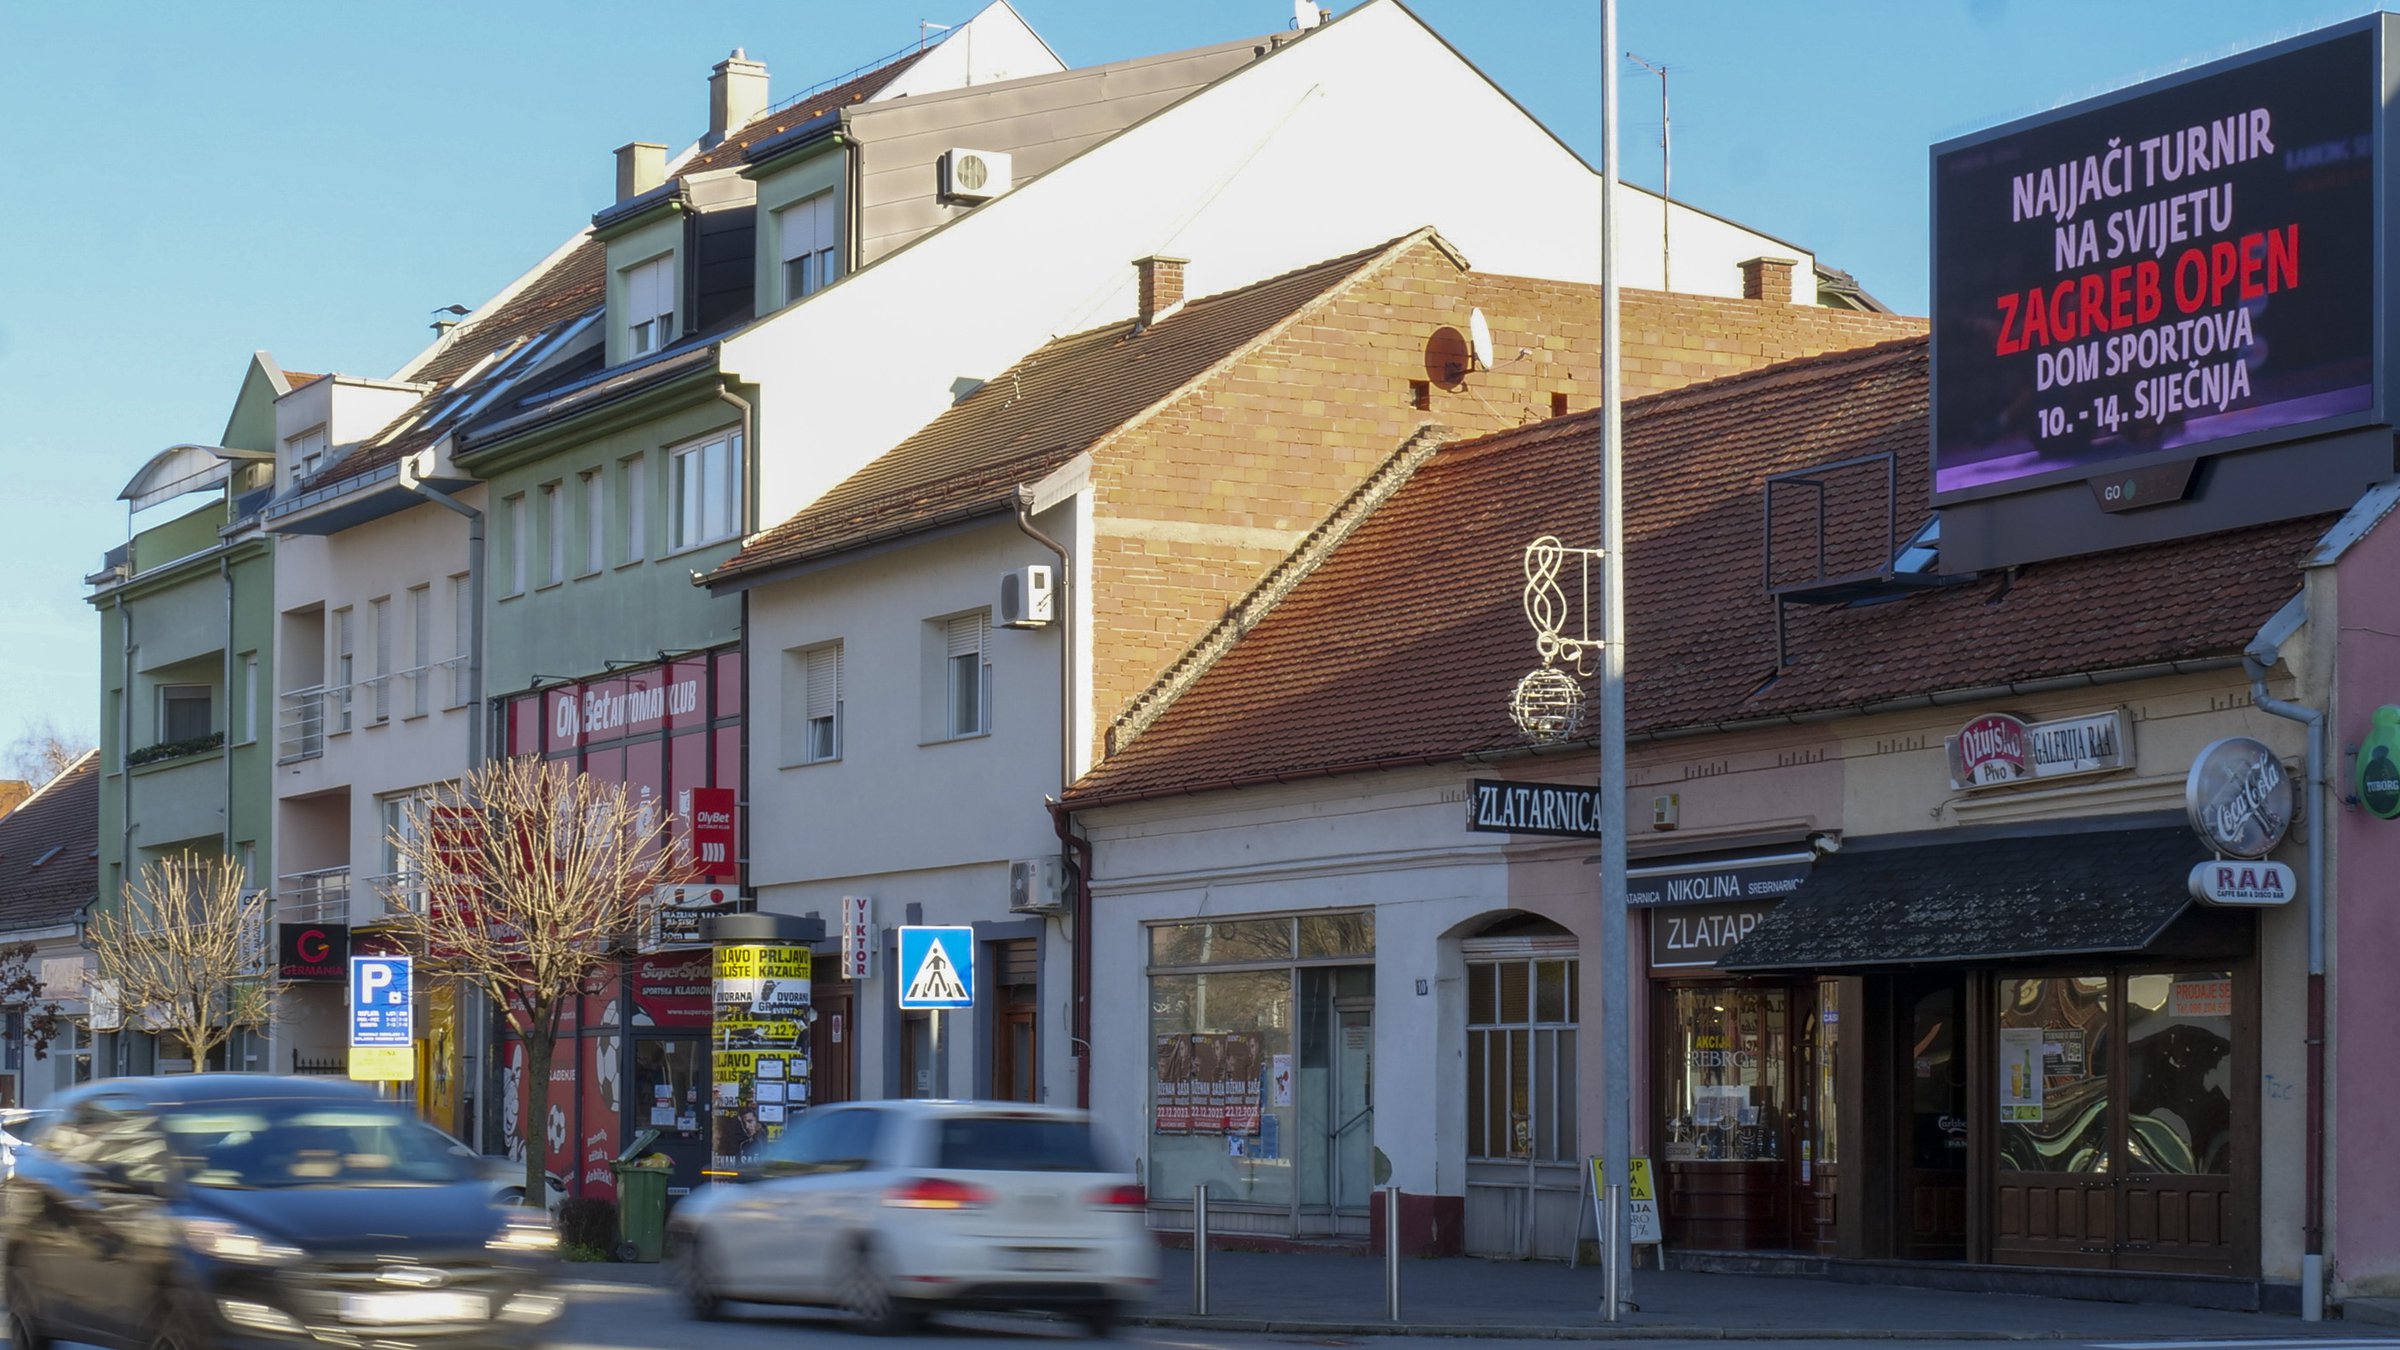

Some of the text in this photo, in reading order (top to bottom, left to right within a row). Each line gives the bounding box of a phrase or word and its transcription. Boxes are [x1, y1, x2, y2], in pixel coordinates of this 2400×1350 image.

[2012, 137, 2134, 223] NAJJAČI
[2140, 106, 2275, 186] TURNIR
[2054, 182, 2234, 273] NA SVIJETU
[1995, 223, 2300, 357] ZAGREB OPEN
[2036, 306, 2254, 393] DOM SPORTOVA
[2134, 360, 2252, 425] SIJEČNJA
[2033, 719, 2114, 770] GALERIJA RAA
[1984, 761, 2007, 782] Pivo
[697, 811, 731, 825] OlyBet
[1478, 785, 1602, 832] ZLATARNICA
[1667, 875, 1741, 902] NIKOLINA
[1748, 878, 1804, 896] SREBRNARNIC
[2215, 867, 2284, 891] RAA
[856, 899, 867, 975] VIKTOR
[282, 965, 344, 976] GERMANIA
[2176, 983, 2217, 1000] PRODAJE
